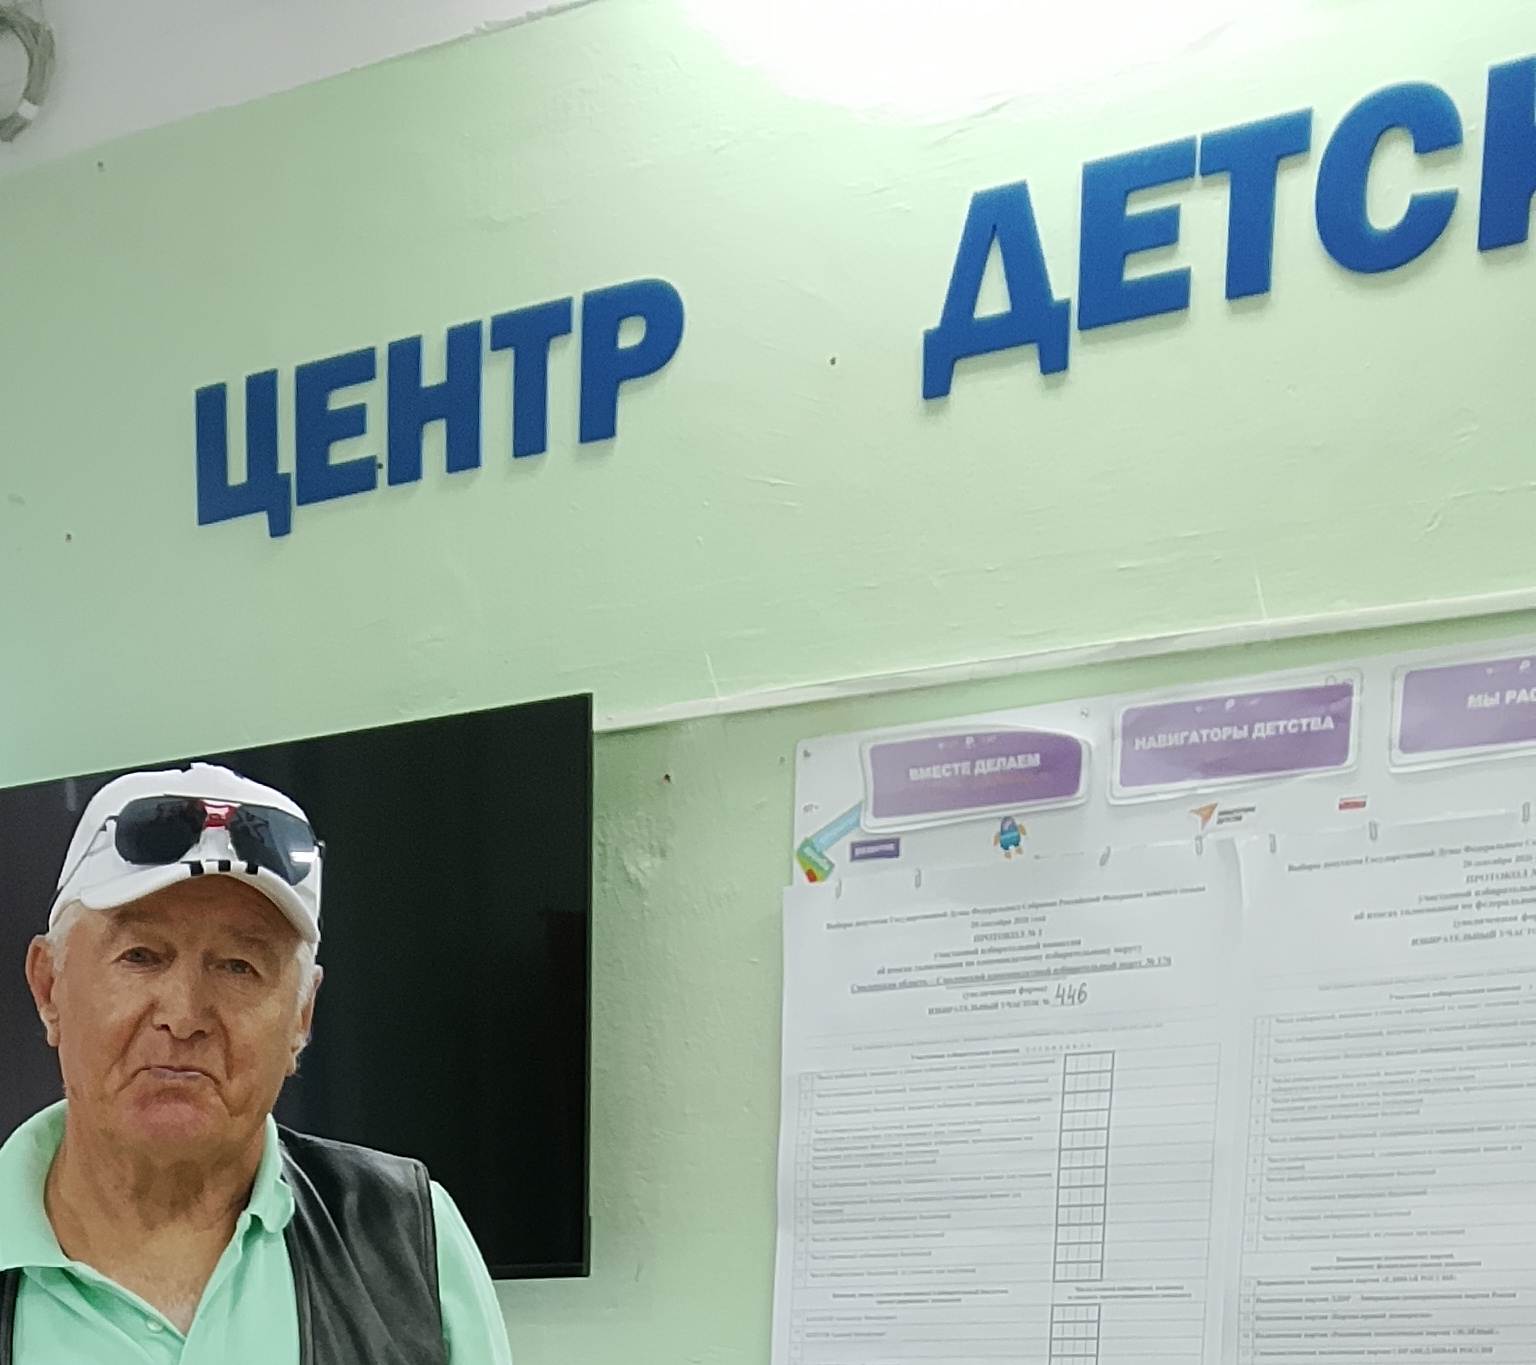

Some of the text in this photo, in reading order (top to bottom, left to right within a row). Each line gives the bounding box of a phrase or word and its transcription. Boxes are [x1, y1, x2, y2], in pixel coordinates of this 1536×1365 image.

[195, 278, 685, 538] ЦЕНТР
[1135, 716, 1334, 750] НАВИГАТОРЫ ДЕТСТВА
[909, 753, 1041, 781] ВМЕСТЕ ДЕЛАЕМ
[1055, 982, 1088, 1005] 446
